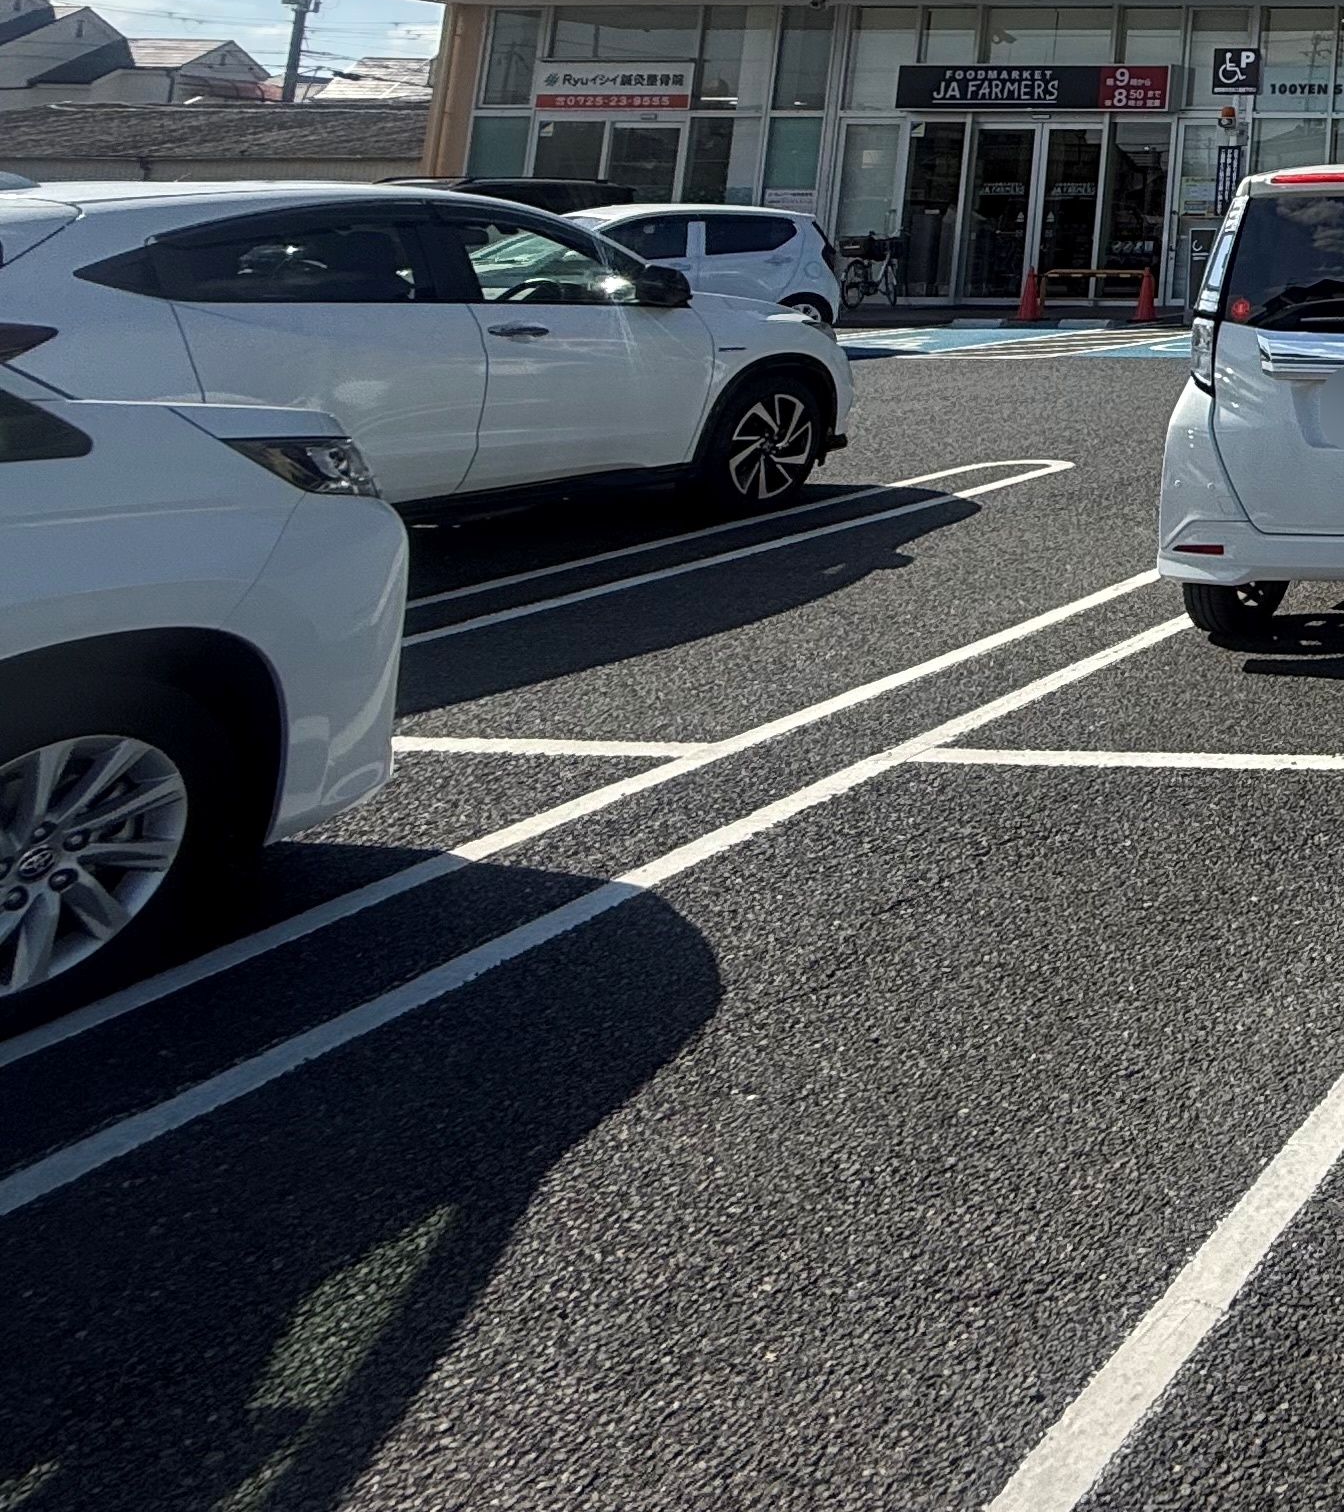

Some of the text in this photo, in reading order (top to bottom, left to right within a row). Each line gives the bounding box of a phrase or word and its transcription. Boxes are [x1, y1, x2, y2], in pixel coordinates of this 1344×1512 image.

[1240, 51, 1255, 68] P
[945, 70, 1053, 80] FOODMARKET
[932, 79, 1059, 100] JA FARMERS
[1270, 83, 1328, 96] 100YEN
